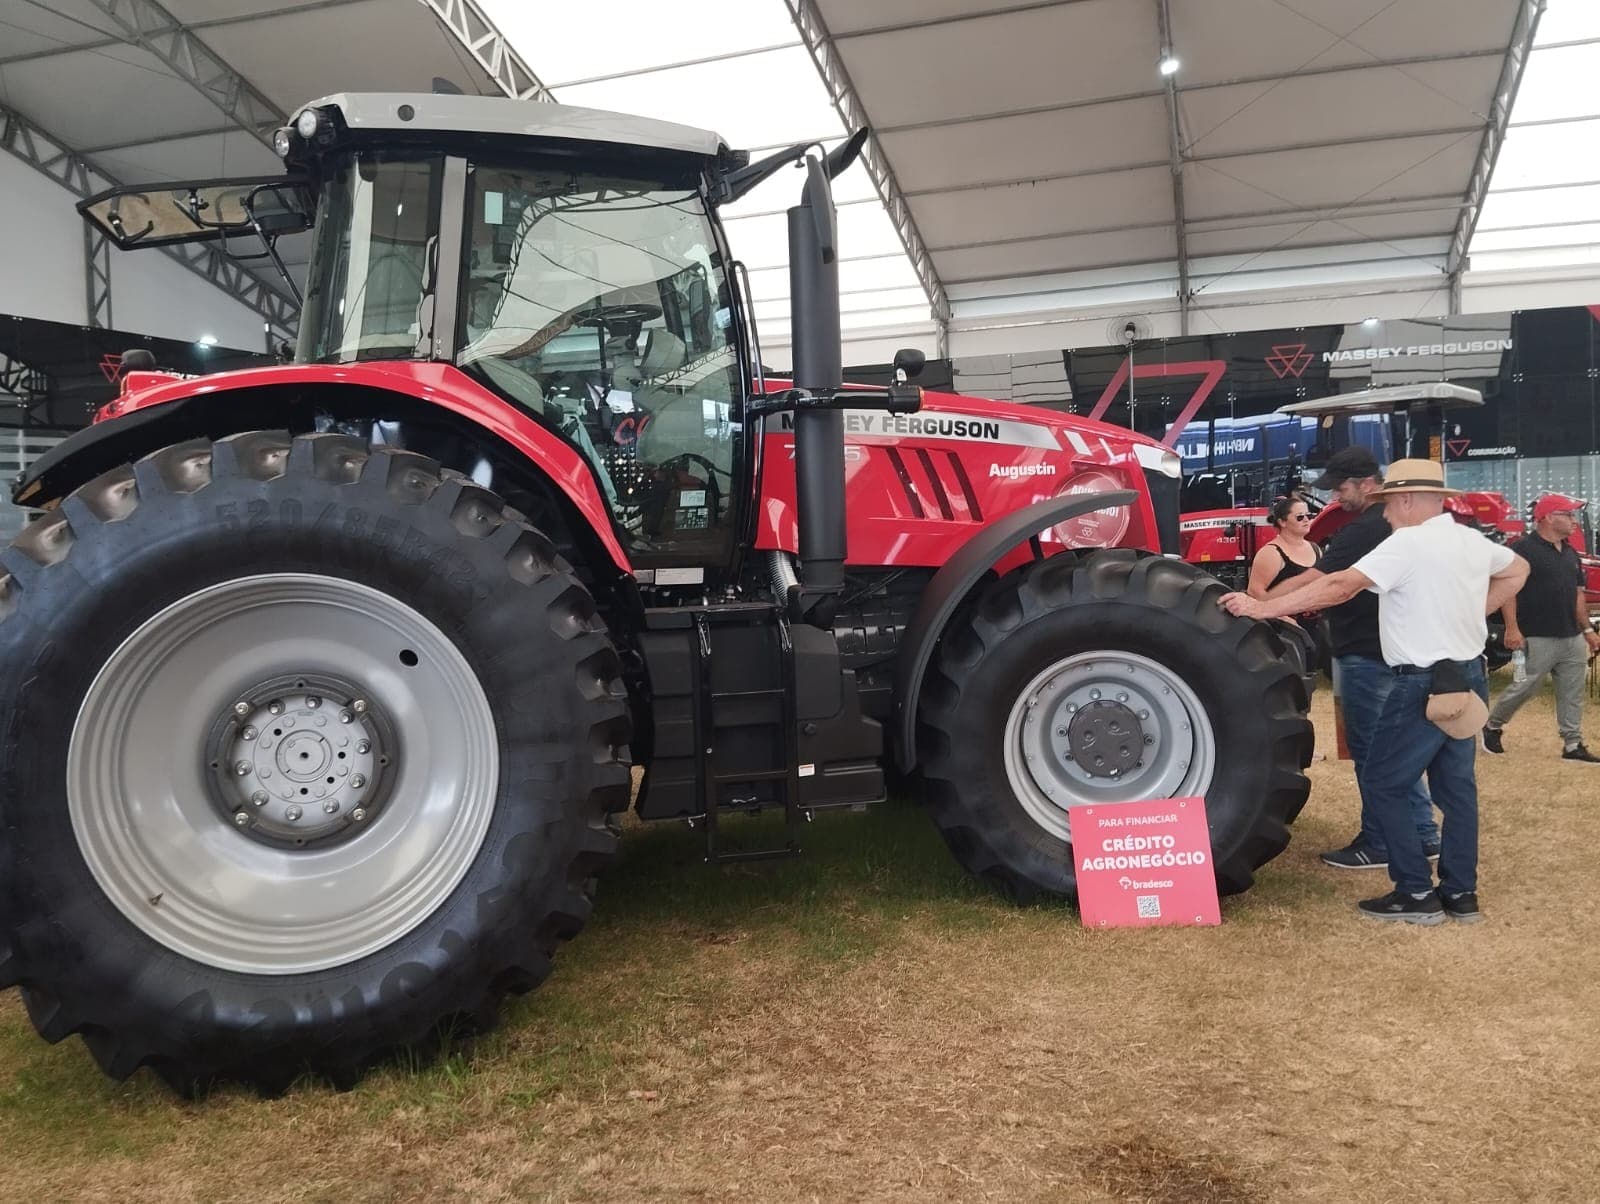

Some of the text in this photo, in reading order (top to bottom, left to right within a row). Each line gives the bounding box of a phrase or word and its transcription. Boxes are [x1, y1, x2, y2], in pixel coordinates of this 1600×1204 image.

[1323, 339, 1513, 363] MASSEY FERGUSON
[782, 412, 1000, 440] MEY FERGUSON
[784, 444, 861, 461] 75
[989, 461, 1056, 480] Augustin
[1183, 520, 1211, 529] MASSEY
[1098, 814, 1178, 829] PARA FINANCIAR
[1102, 835, 1175, 852] CRÉDITO
[1081, 849, 1206, 872] AGRONEGÓCIO
[1132, 879, 1174, 890] bradesco
